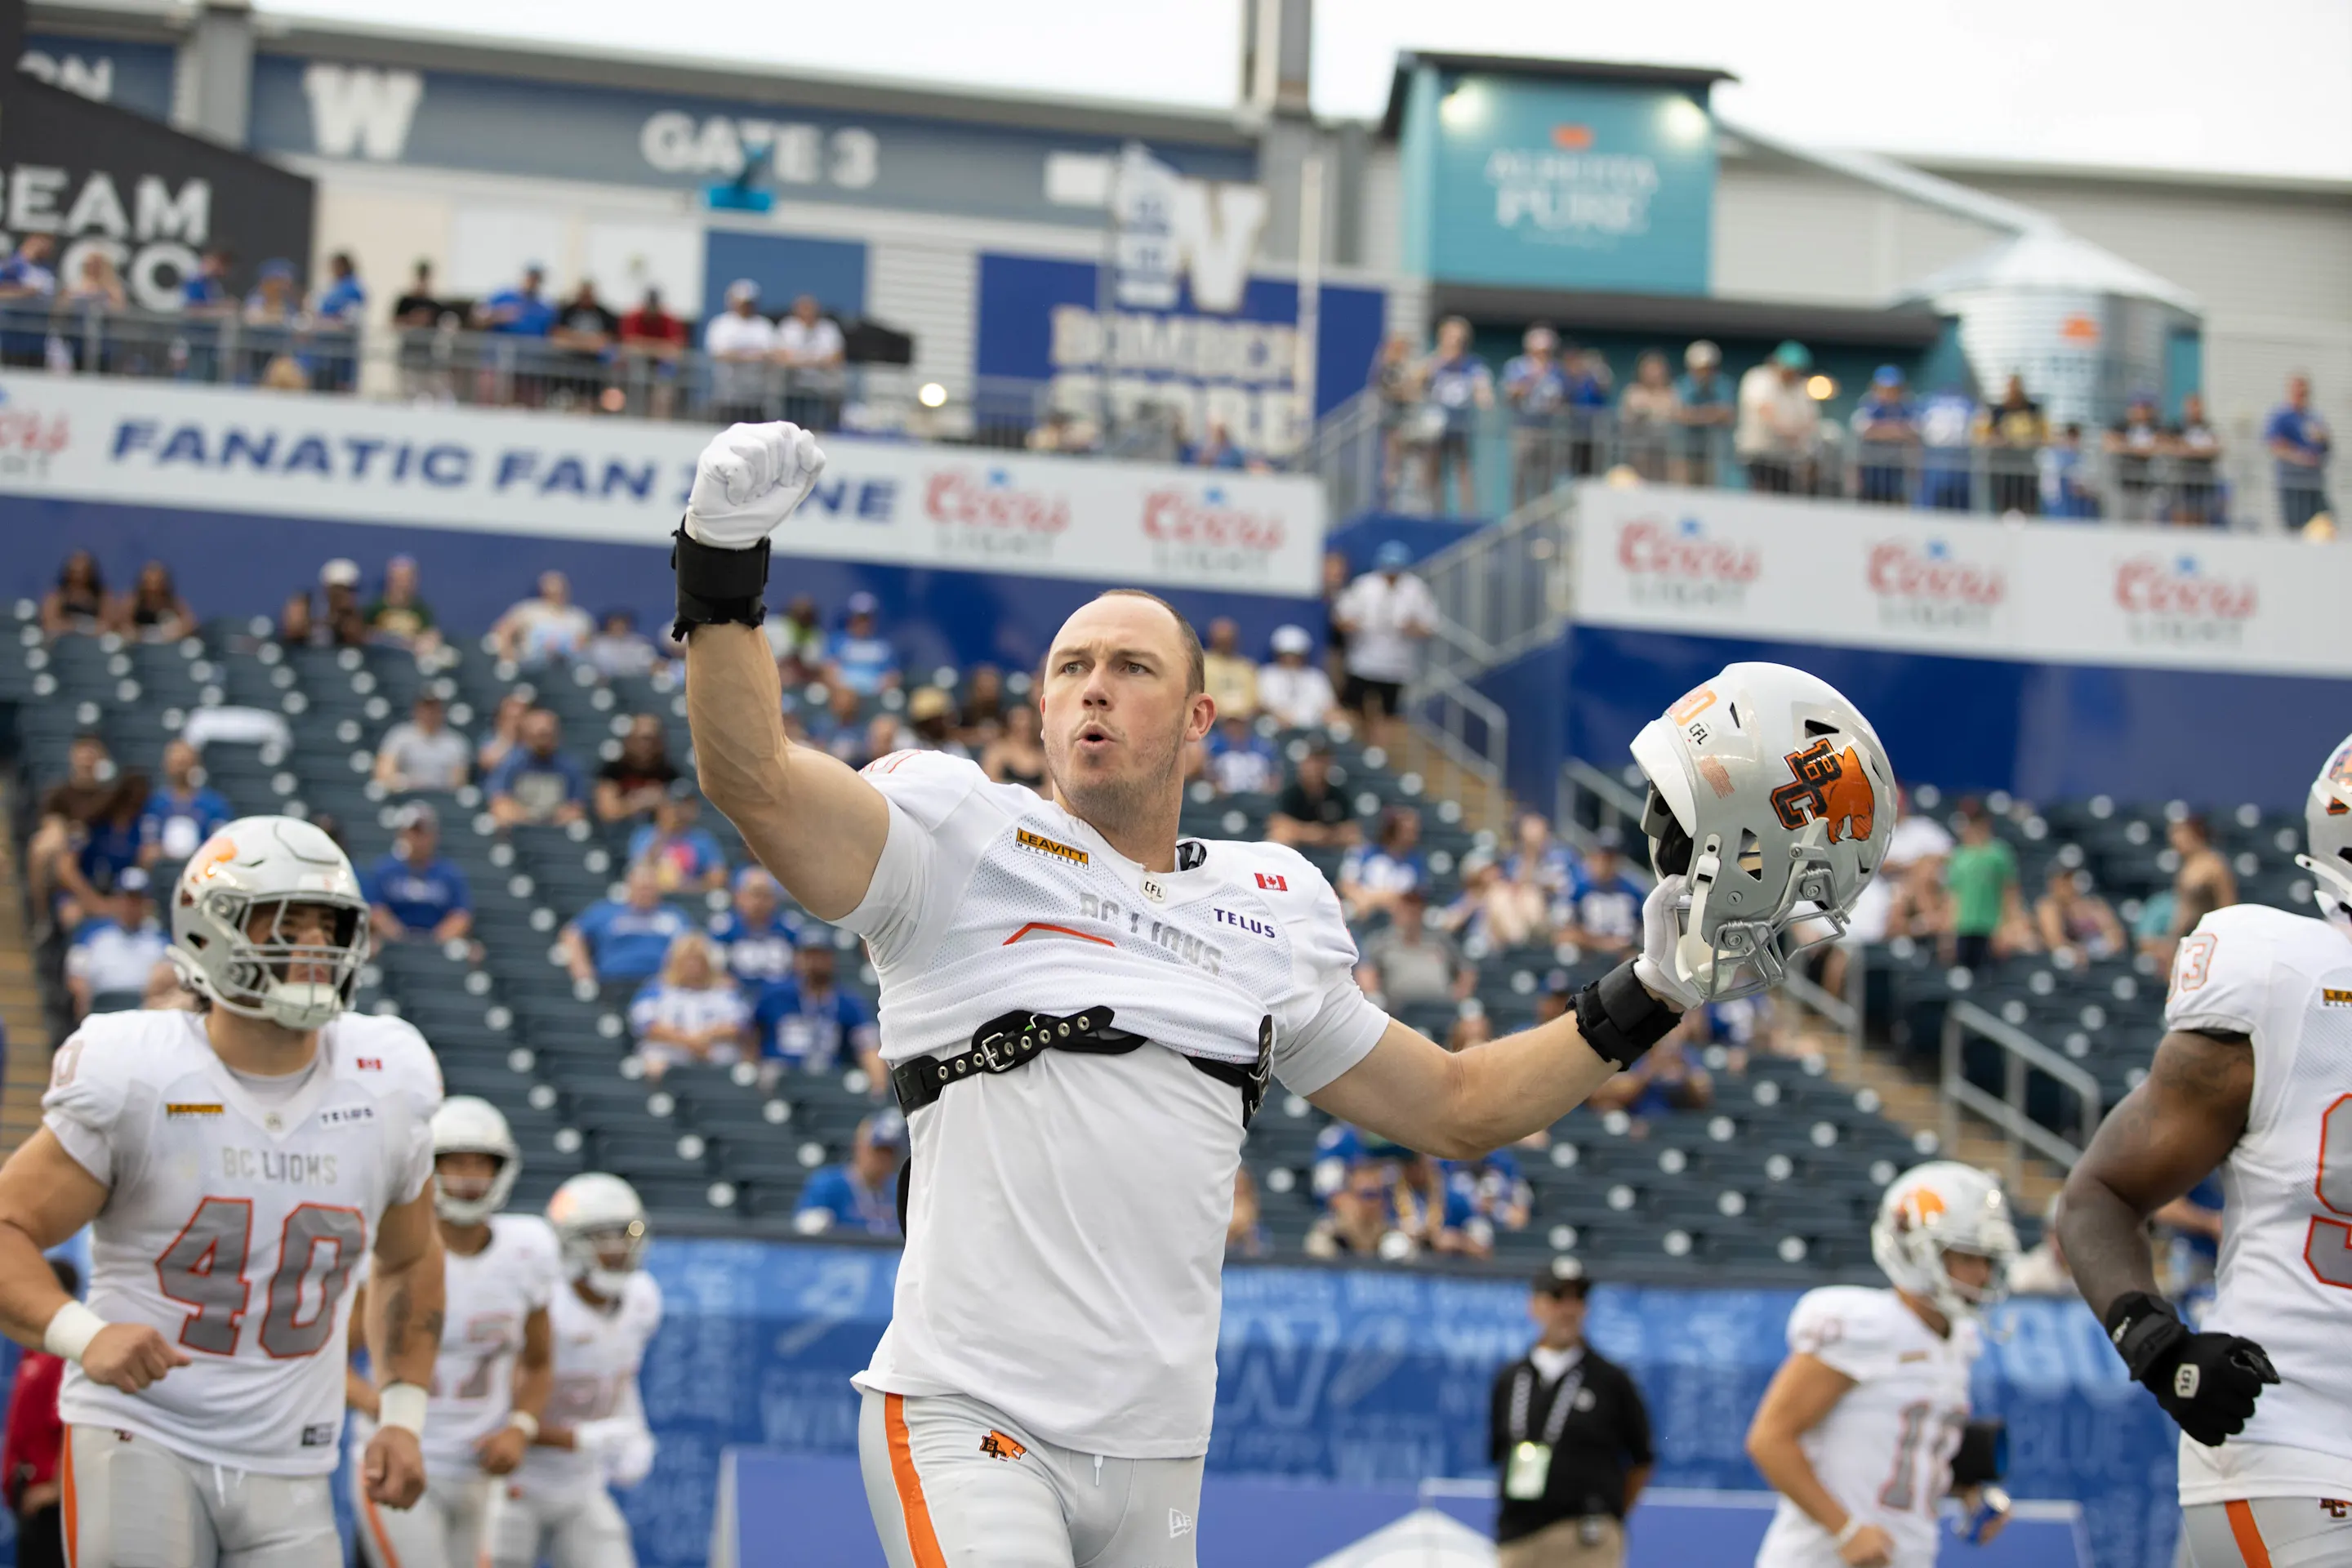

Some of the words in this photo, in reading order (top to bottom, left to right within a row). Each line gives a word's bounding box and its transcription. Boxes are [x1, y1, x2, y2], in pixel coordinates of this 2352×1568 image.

[304, 64, 423, 160] W
[830, 127, 880, 190] 3
[0, 163, 212, 247] EAM
[109, 416, 472, 490] FANATIC
[493, 447, 655, 502] FAN
[1689, 722, 1709, 746] CFL
[1017, 842, 1088, 869] MACHINERY
[1018, 831, 1087, 861] LEAVITT
[1144, 880, 1164, 899] CFL
[1213, 908, 1276, 939] TELUS
[322, 1107, 374, 1123] TELUS
[223, 1147, 256, 1178] BC
[262, 1150, 338, 1185] LIONS
[154, 1195, 367, 1361] 40
